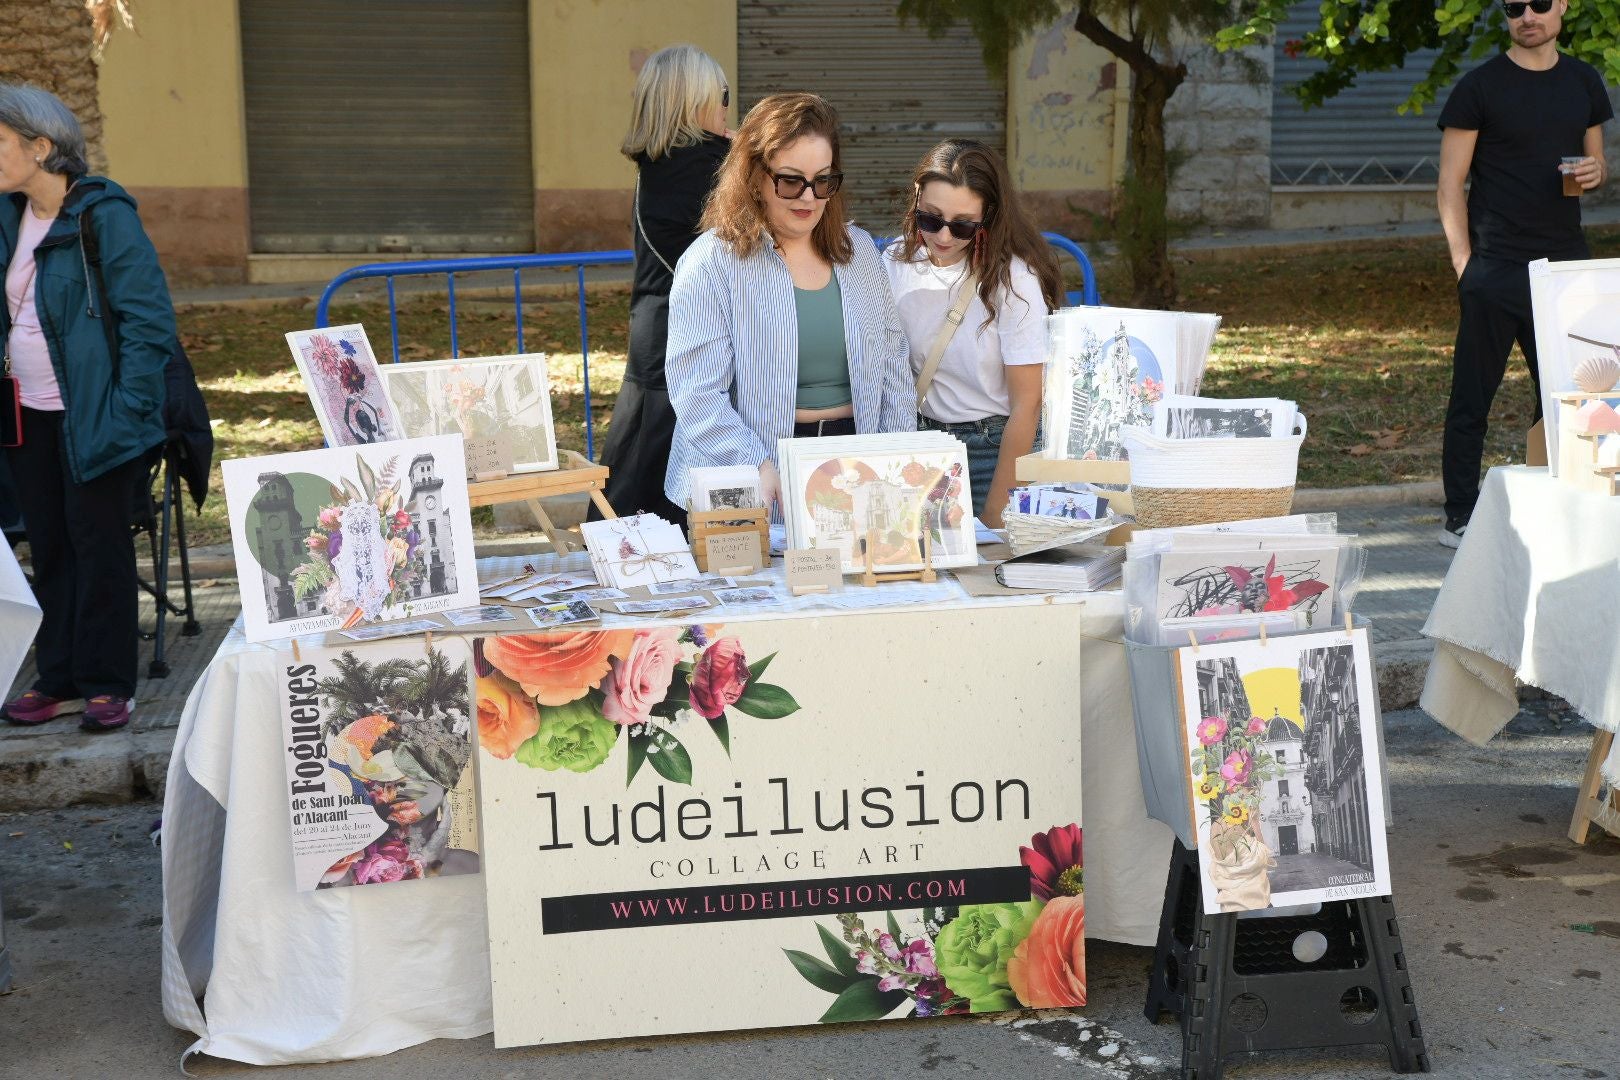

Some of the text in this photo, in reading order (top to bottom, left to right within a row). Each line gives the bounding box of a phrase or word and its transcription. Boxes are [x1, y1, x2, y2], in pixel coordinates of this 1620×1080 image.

[286, 664, 328, 796] Fogueres
[292, 794, 363, 811] de Sant Joan
[293, 808, 348, 826] d'Alacant
[535, 769, 1032, 851] ludeilusion
[649, 843, 928, 880] COLLAGE ART
[610, 878, 968, 920] WWW.LUDEILUSION.COM
